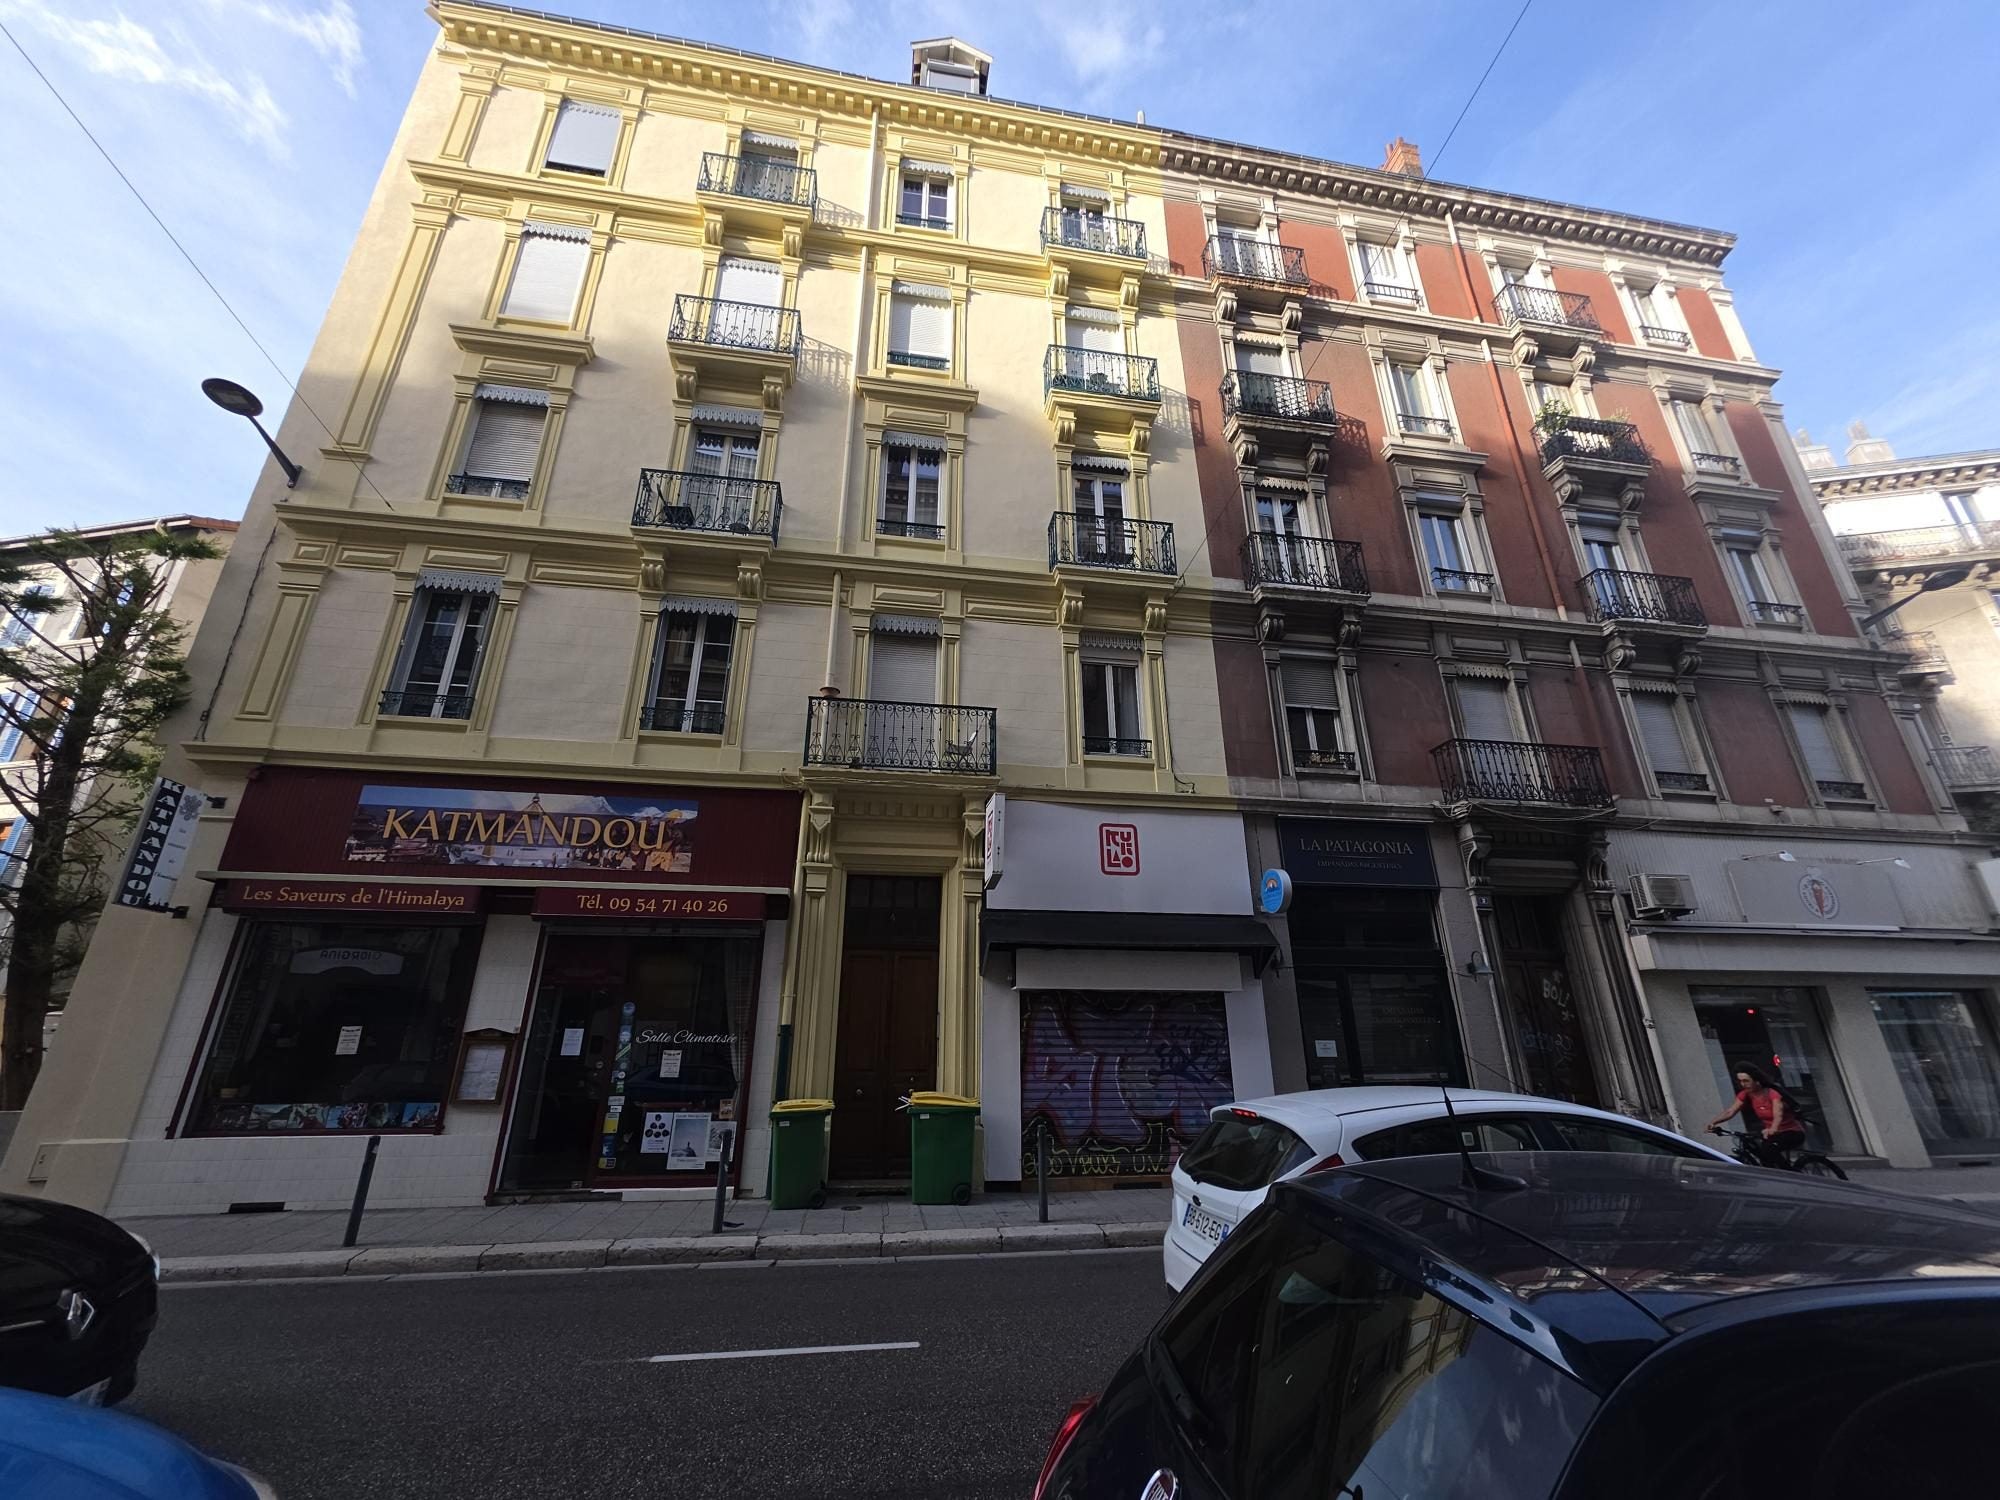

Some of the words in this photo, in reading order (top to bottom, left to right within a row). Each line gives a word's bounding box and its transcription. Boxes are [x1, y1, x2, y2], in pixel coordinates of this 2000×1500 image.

[382, 808, 666, 850] KATMANDOU
[121, 780, 184, 906] KATMANDOU
[1299, 838, 1322, 851] LA
[1325, 838, 1414, 855] PATAGONIA
[243, 886, 272, 900] Les
[277, 887, 346, 903] Saveurs
[351, 888, 372, 903] de
[377, 888, 465, 910] l'Himalaya
[577, 894, 604, 909] Tél.
[609, 897, 631, 910] 09
[635, 898, 657, 912] 54
[661, 899, 677, 912] 71
[681, 900, 703, 913] 40
[707, 899, 728, 912] 26
[635, 1030, 671, 1043] Salle
